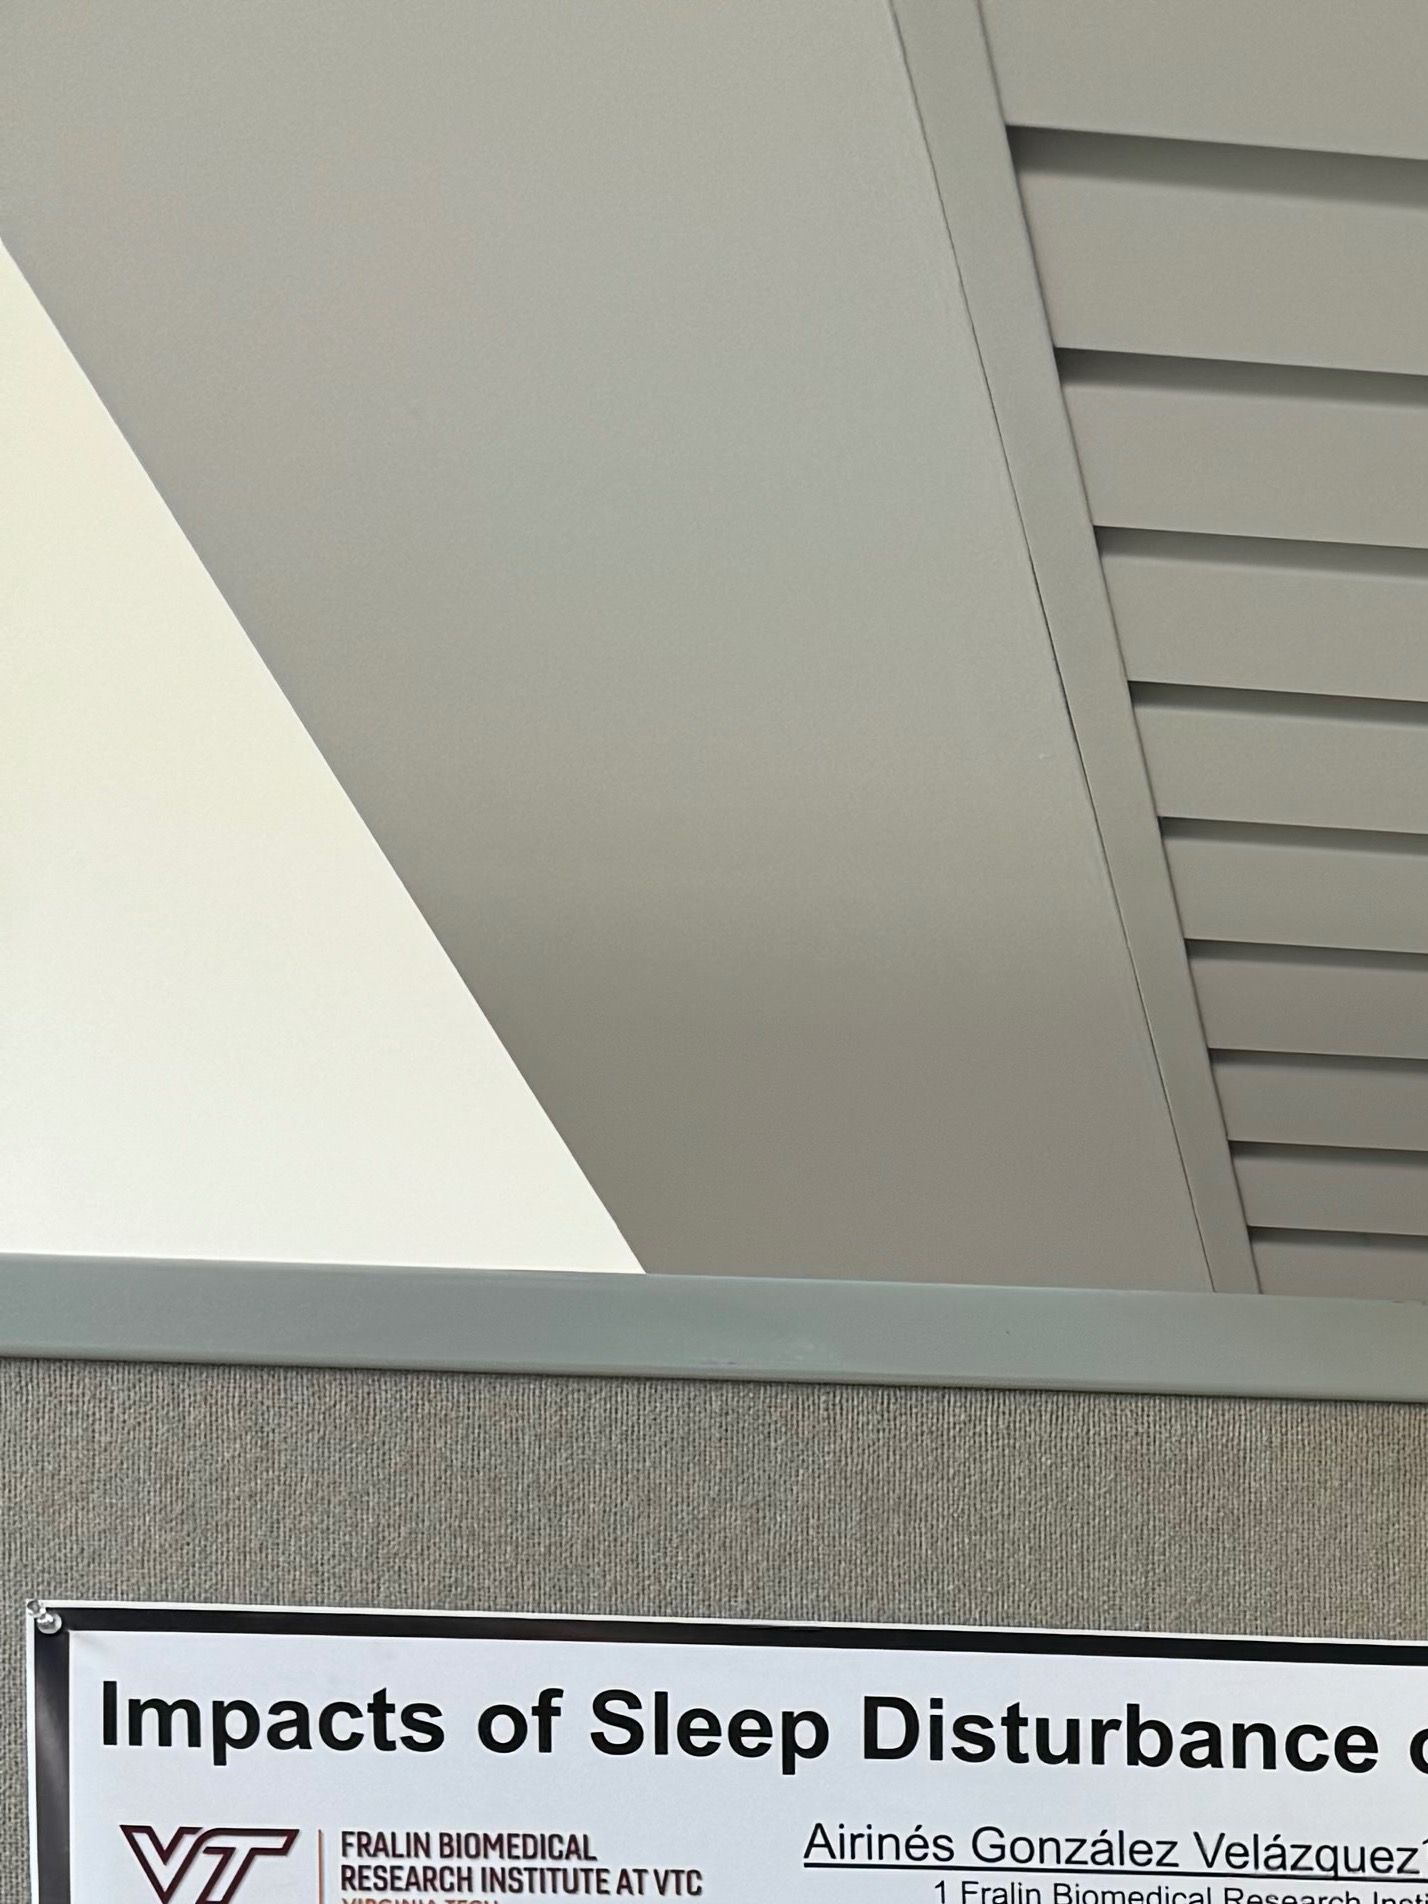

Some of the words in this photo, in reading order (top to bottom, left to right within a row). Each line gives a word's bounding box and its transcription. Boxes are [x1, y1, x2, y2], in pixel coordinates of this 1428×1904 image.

[102, 1680, 445, 1767] Impacts
[477, 1687, 565, 1754] of
[590, 1689, 830, 1776] Sleep
[863, 1695, 1379, 1774] Disturbance
[341, 1830, 431, 1859] FRALIN
[438, 1832, 598, 1862] BIOMEDICAL
[804, 1822, 955, 1865] Airinés
[971, 1825, 1180, 1870] González
[340, 1864, 474, 1893] RESEARCH
[480, 1866, 611, 1896] INSTITUTE
[616, 1868, 649, 1896] AT
[653, 1868, 703, 1897] VTC
